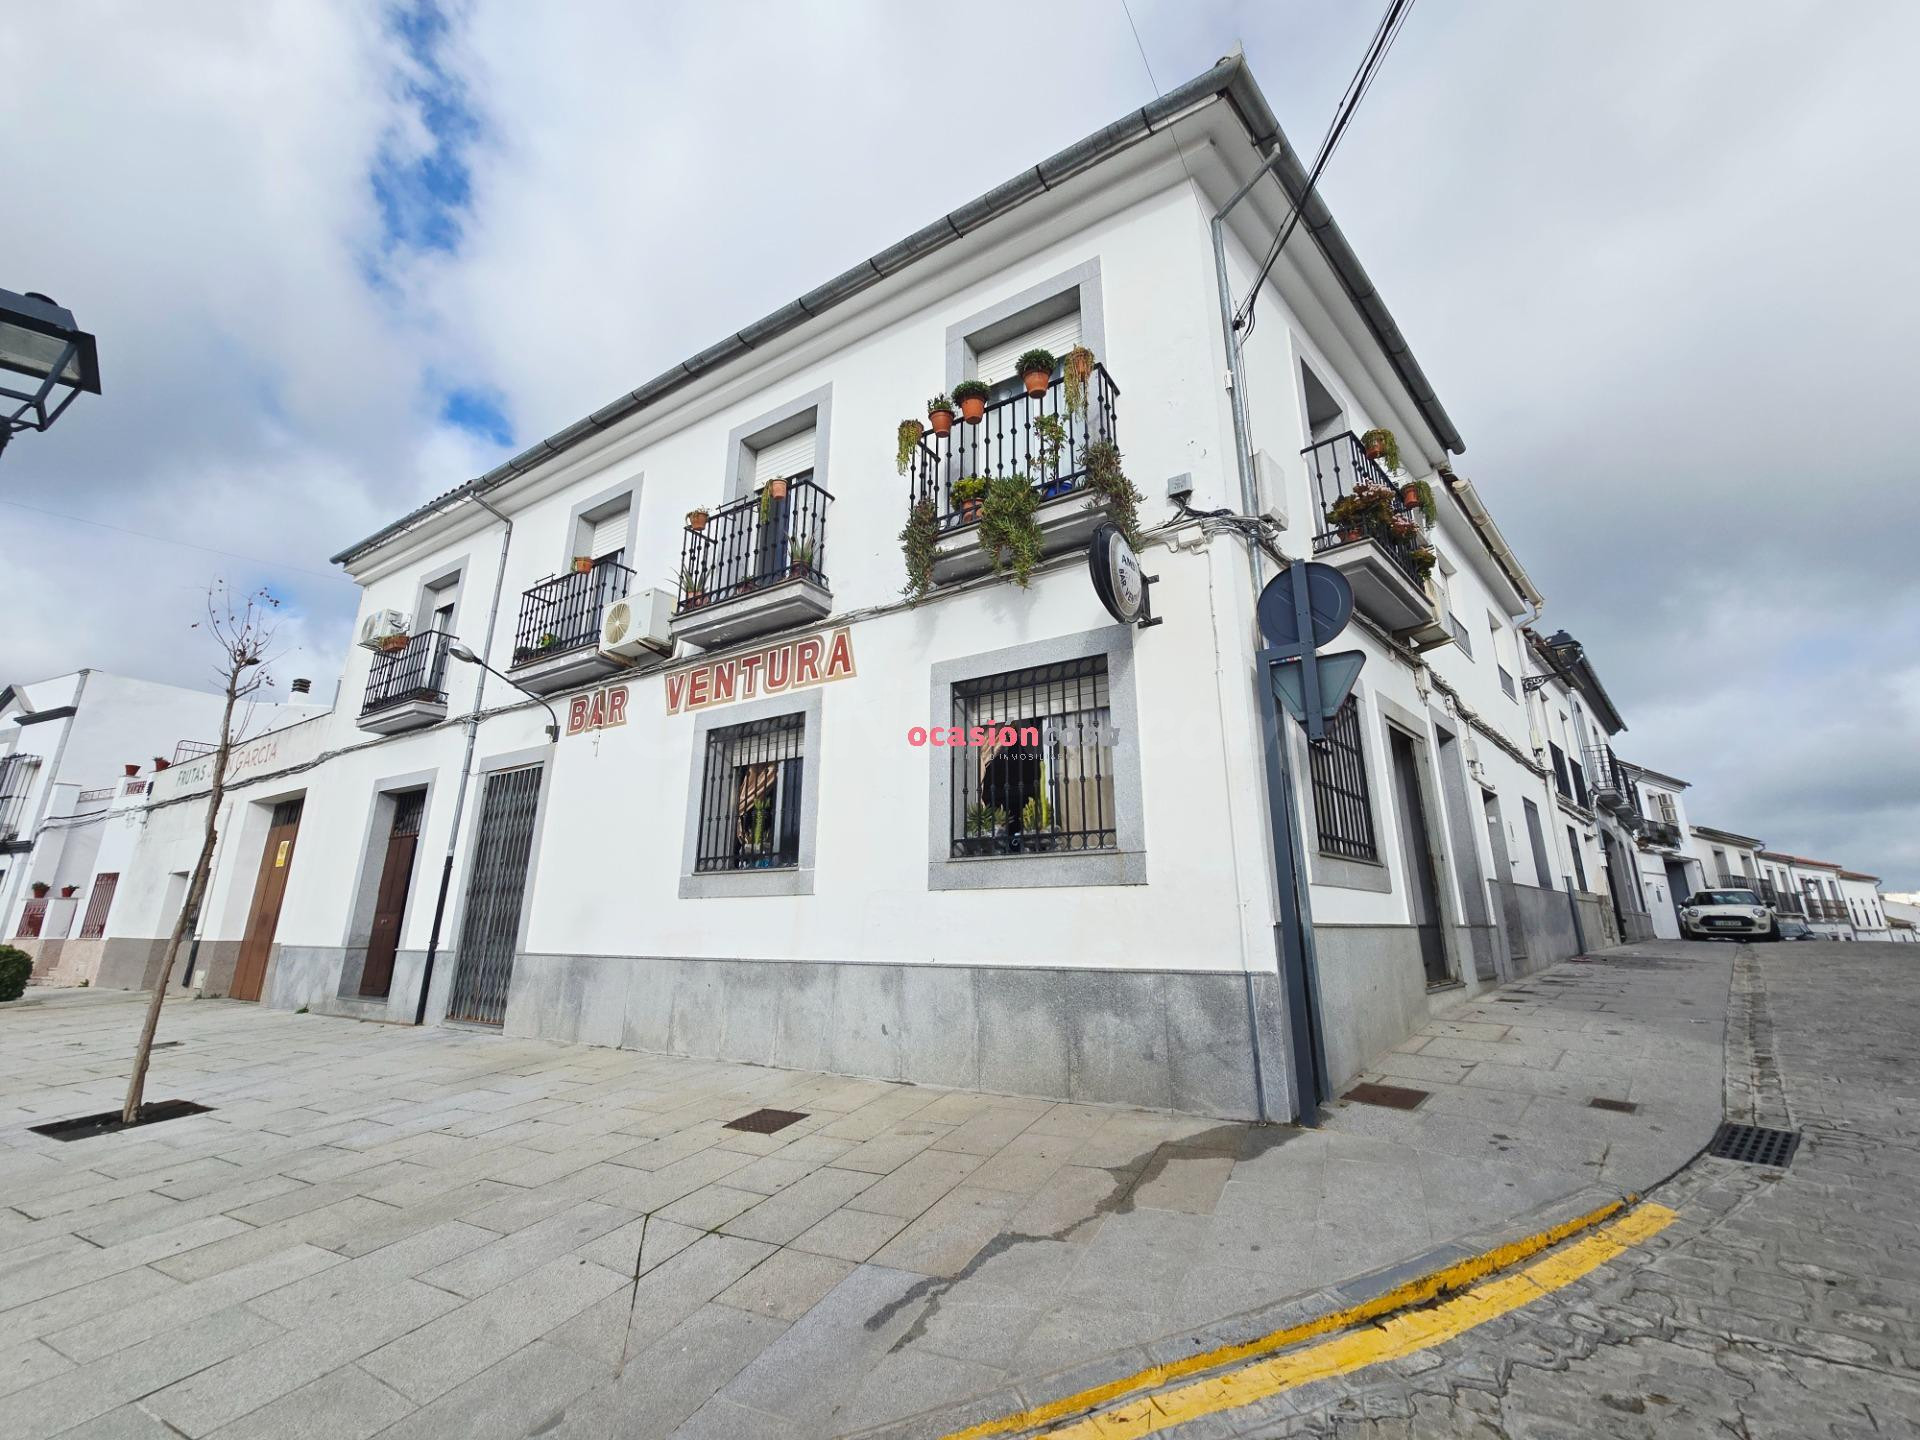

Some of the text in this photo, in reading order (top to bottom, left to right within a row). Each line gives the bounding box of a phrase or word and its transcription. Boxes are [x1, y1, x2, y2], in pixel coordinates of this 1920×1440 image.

[1118, 568, 1127, 588] BAR
[567, 629, 856, 735] BAR VENTURA
[177, 742, 279, 786] FRUTAS JN GARCIA
